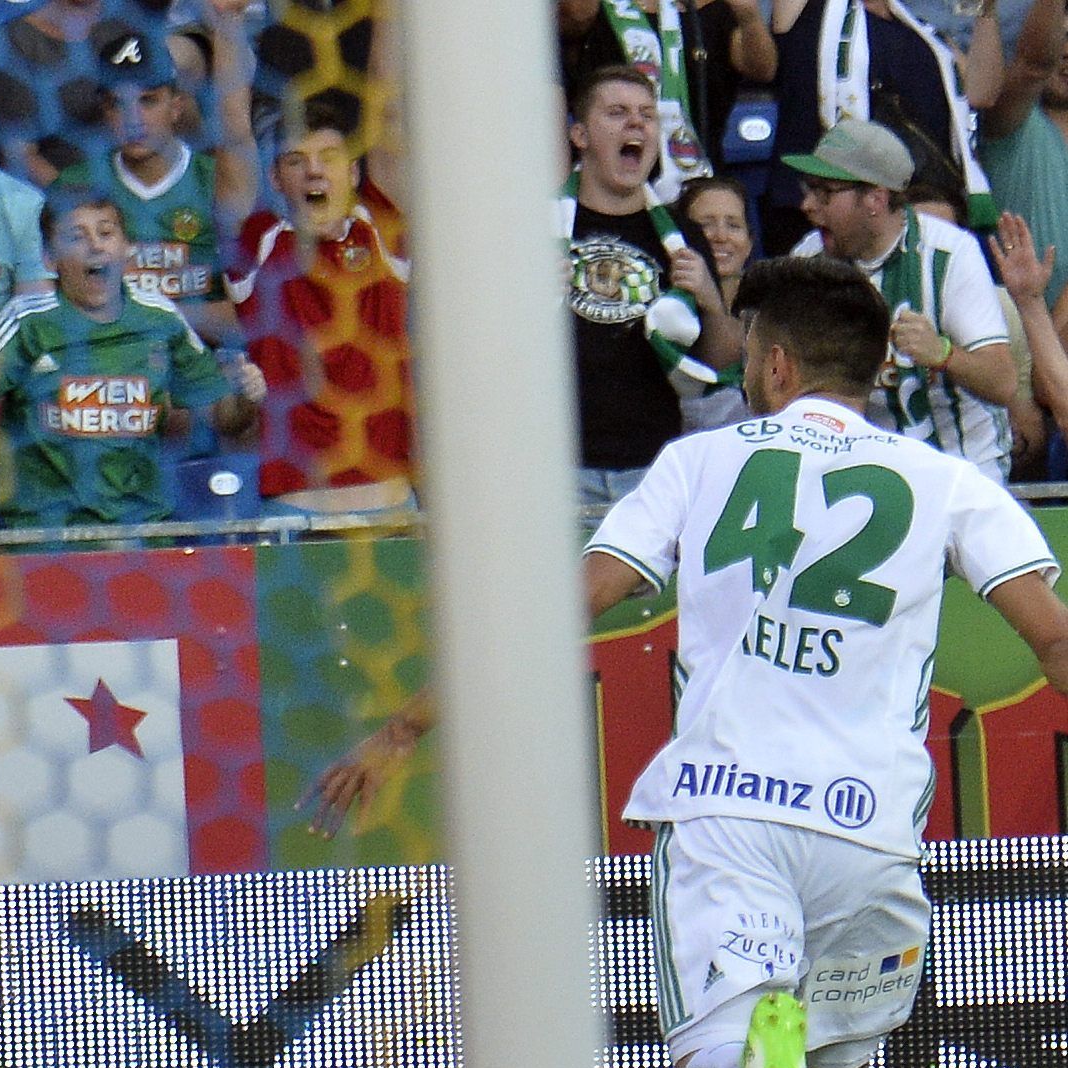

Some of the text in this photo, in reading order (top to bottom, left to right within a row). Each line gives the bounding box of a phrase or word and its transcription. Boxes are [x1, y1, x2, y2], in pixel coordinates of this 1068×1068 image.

[126, 243, 184, 269] IEN
[65, 379, 147, 405] WIEN
[737, 420, 783, 439] cb
[703, 448, 915, 628] 42
[672, 762, 813, 812] Allianz
[816, 962, 871, 983] card
[811, 973, 915, 1004] complete
